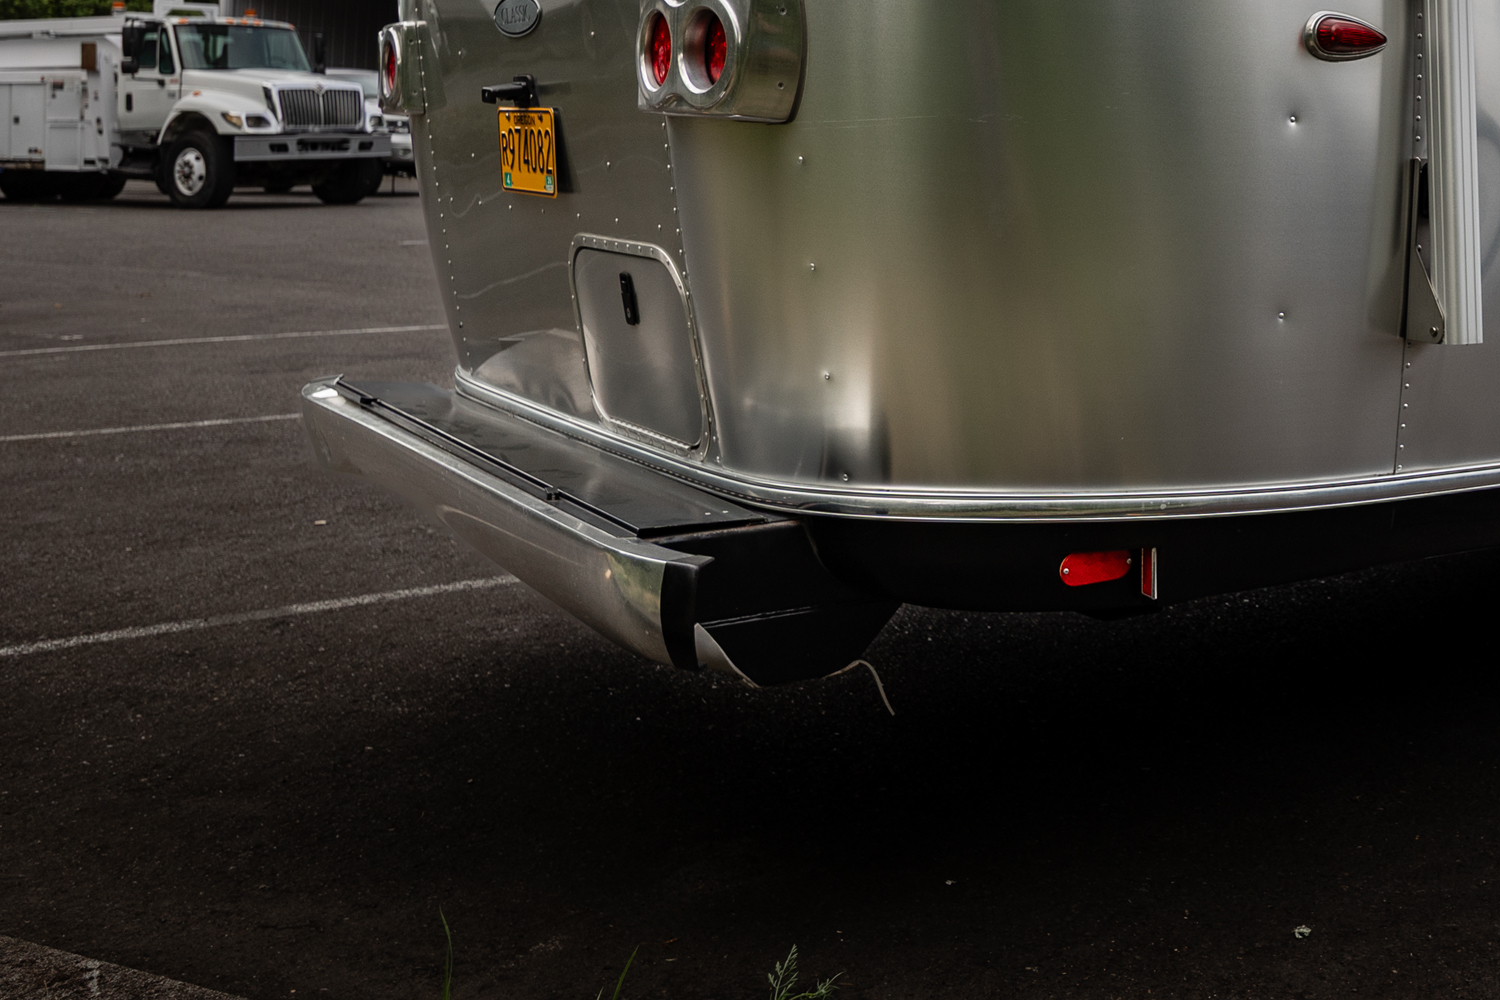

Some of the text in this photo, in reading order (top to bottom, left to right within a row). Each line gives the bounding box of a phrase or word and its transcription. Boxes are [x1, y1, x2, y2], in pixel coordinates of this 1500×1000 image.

[501, 4, 531, 25] CLASSIC
[513, 114, 536, 126] OREGON
[501, 127, 553, 174] R974082
